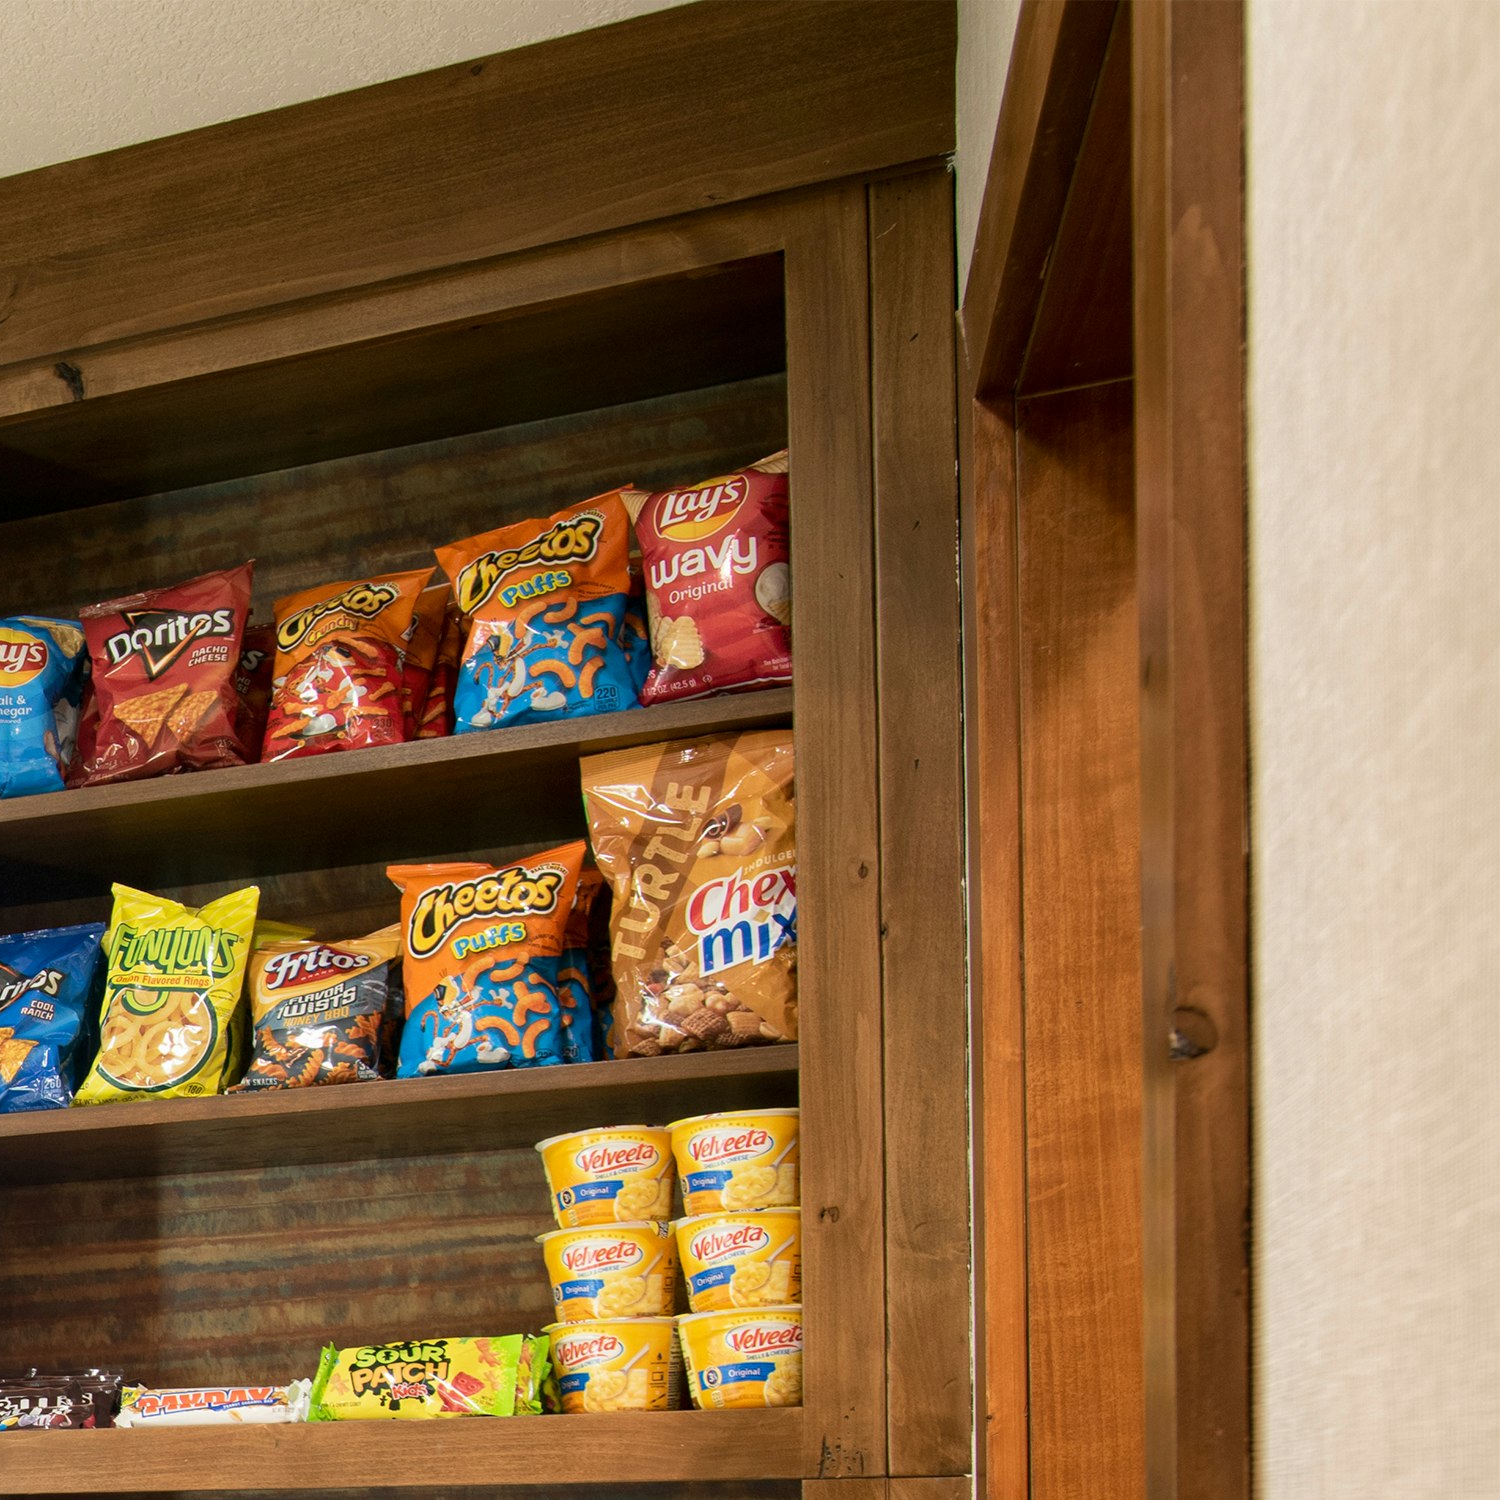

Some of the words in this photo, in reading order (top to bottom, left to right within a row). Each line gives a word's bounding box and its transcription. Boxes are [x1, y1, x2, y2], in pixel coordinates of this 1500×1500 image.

[663, 478, 744, 527] Lay's
[458, 516, 603, 614] Cheetos
[651, 534, 758, 587] wavy
[501, 570, 572, 608] Puffs
[669, 580, 734, 604] Original
[107, 610, 233, 664] Doritos
[305, 616, 358, 646] Crunchy
[188, 653, 228, 667] CHEESE
[191, 646, 228, 659] NACHO
[17, 695, 26, 706] &
[612, 783, 711, 963] TURTLE
[409, 868, 561, 956] Cheetos
[690, 868, 797, 932] Chex
[453, 922, 526, 957] Puffs
[115, 975, 137, 985] Onion
[140, 976, 181, 986] Flavored
[184, 977, 210, 989] Rings
[263, 946, 370, 990] Fritos
[30, 1000, 55, 1012] COOL
[277, 989, 357, 1020] TWISTS
[289, 984, 345, 1008] FLAVOR
[21, 1006, 54, 1021] RANCH
[284, 1012, 321, 1027] HONEY
[324, 1007, 350, 1023] BBQ
[581, 1142, 658, 1173] Velveeta
[692, 1128, 768, 1161] Velveeta
[580, 1186, 609, 1199] Original
[566, 1240, 638, 1270] Velveeta
[694, 1226, 764, 1261] Velveeta
[356, 1344, 445, 1367] SOUR
[558, 1335, 619, 1366] Velveeta
[351, 1362, 449, 1395] PATCH
[728, 1367, 761, 1379] Original
[138, 1387, 276, 1417] PAYDAY
[391, 1382, 430, 1399] Kids
